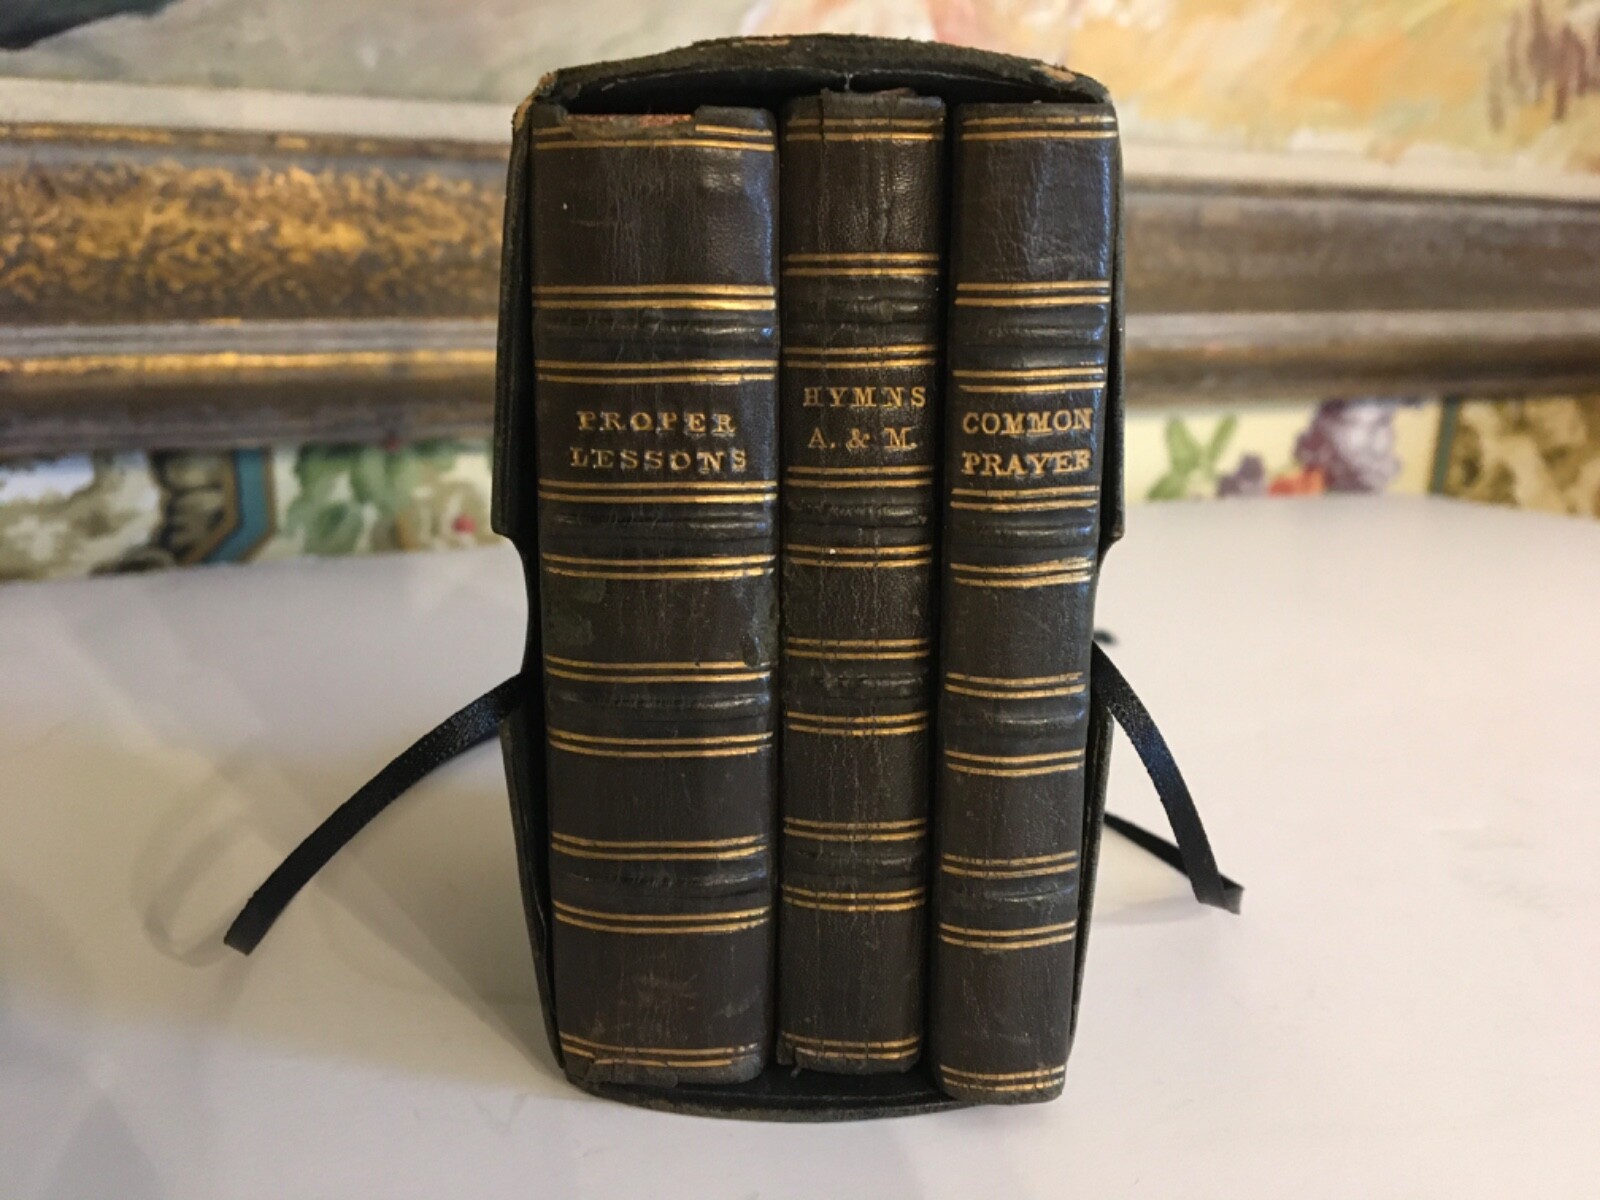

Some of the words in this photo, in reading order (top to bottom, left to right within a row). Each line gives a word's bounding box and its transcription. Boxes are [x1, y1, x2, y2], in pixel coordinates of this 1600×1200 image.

[803, 386, 926, 408] HYMNS
[577, 410, 736, 435] PROPER
[962, 407, 1093, 436] COMMON
[808, 426, 836, 449] A.
[846, 427, 870, 450] &
[883, 426, 918, 451] M.
[570, 446, 747, 472] LESSONS
[961, 448, 1092, 477] PRAYER
